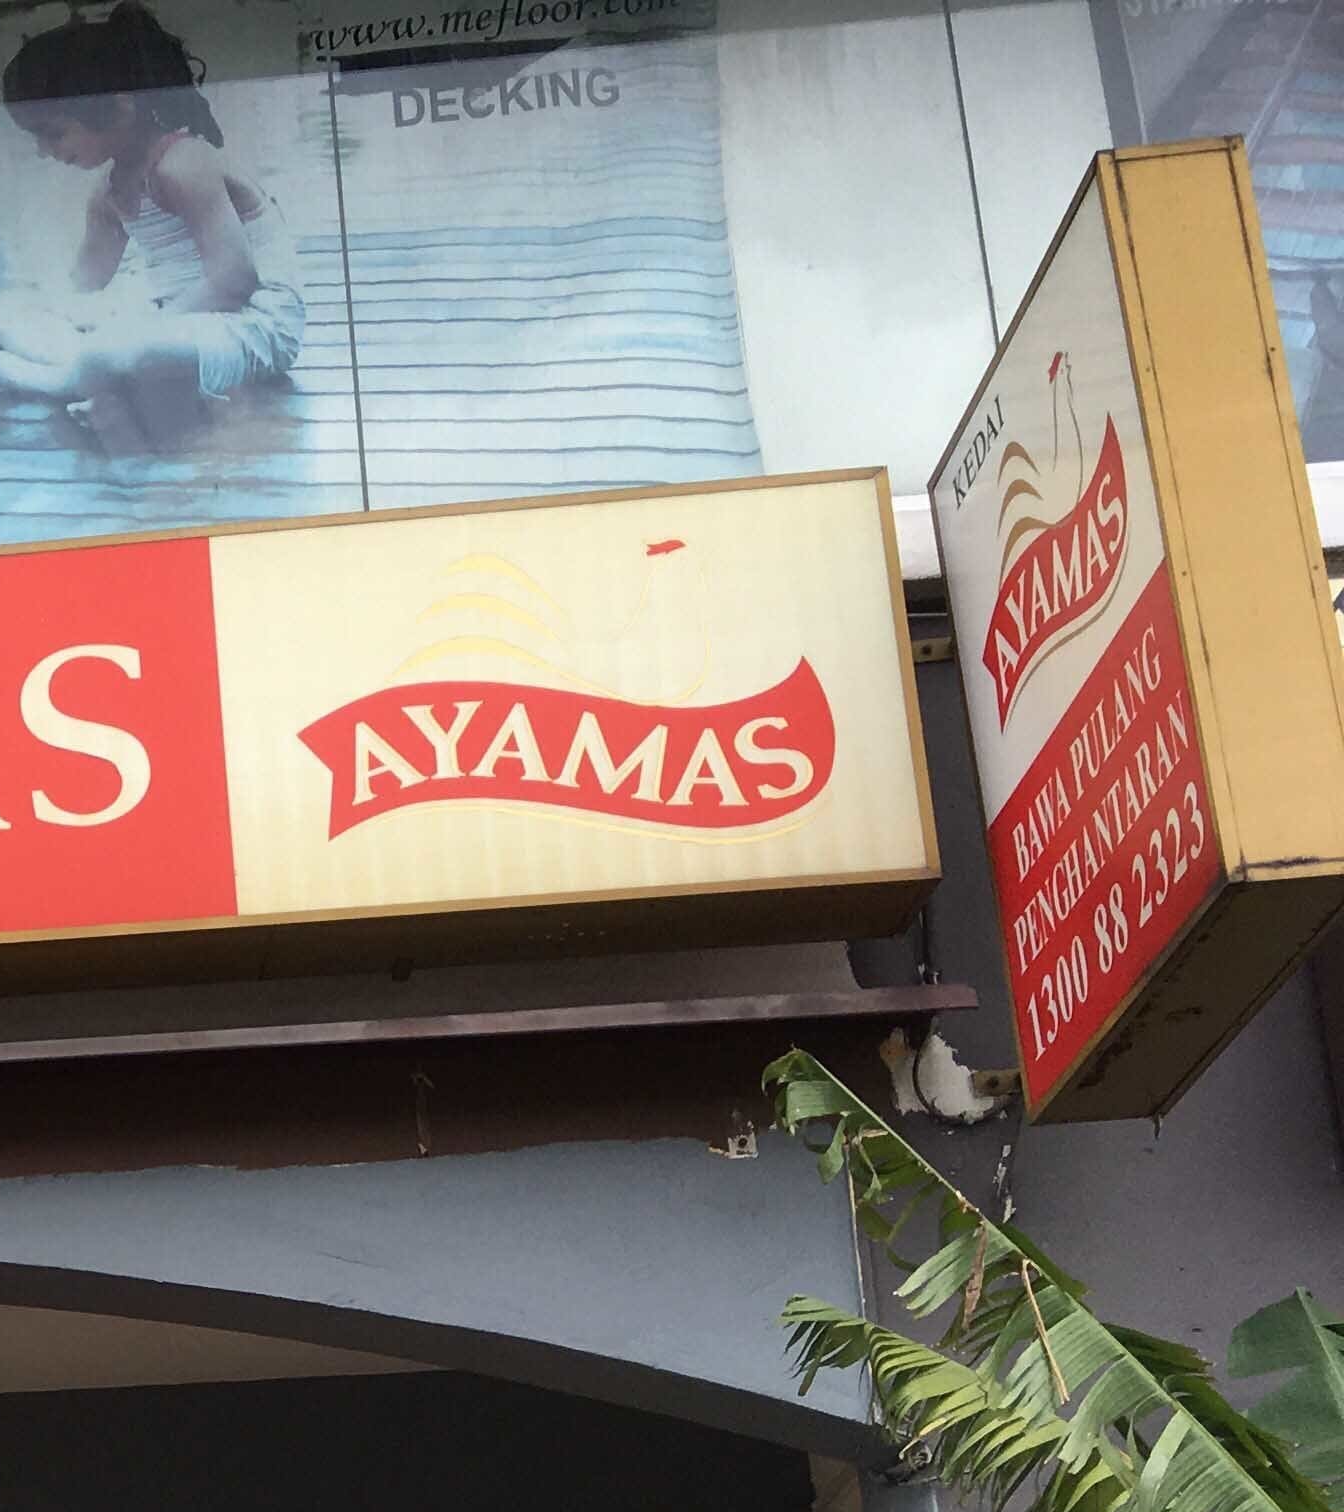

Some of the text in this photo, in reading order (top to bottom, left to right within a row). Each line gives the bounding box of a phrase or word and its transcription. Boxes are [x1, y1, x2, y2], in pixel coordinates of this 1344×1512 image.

[393, 68, 620, 128] DECKING
[953, 395, 1005, 511] KEDAI
[994, 473, 1125, 703] AYAMAS
[352, 701, 814, 806] AYAMAS
[1013, 624, 1162, 883] BAWA PULANG
[1013, 690, 1189, 976] PENGHANTARAN
[1026, 781, 1205, 1061] 1300 88 2323
